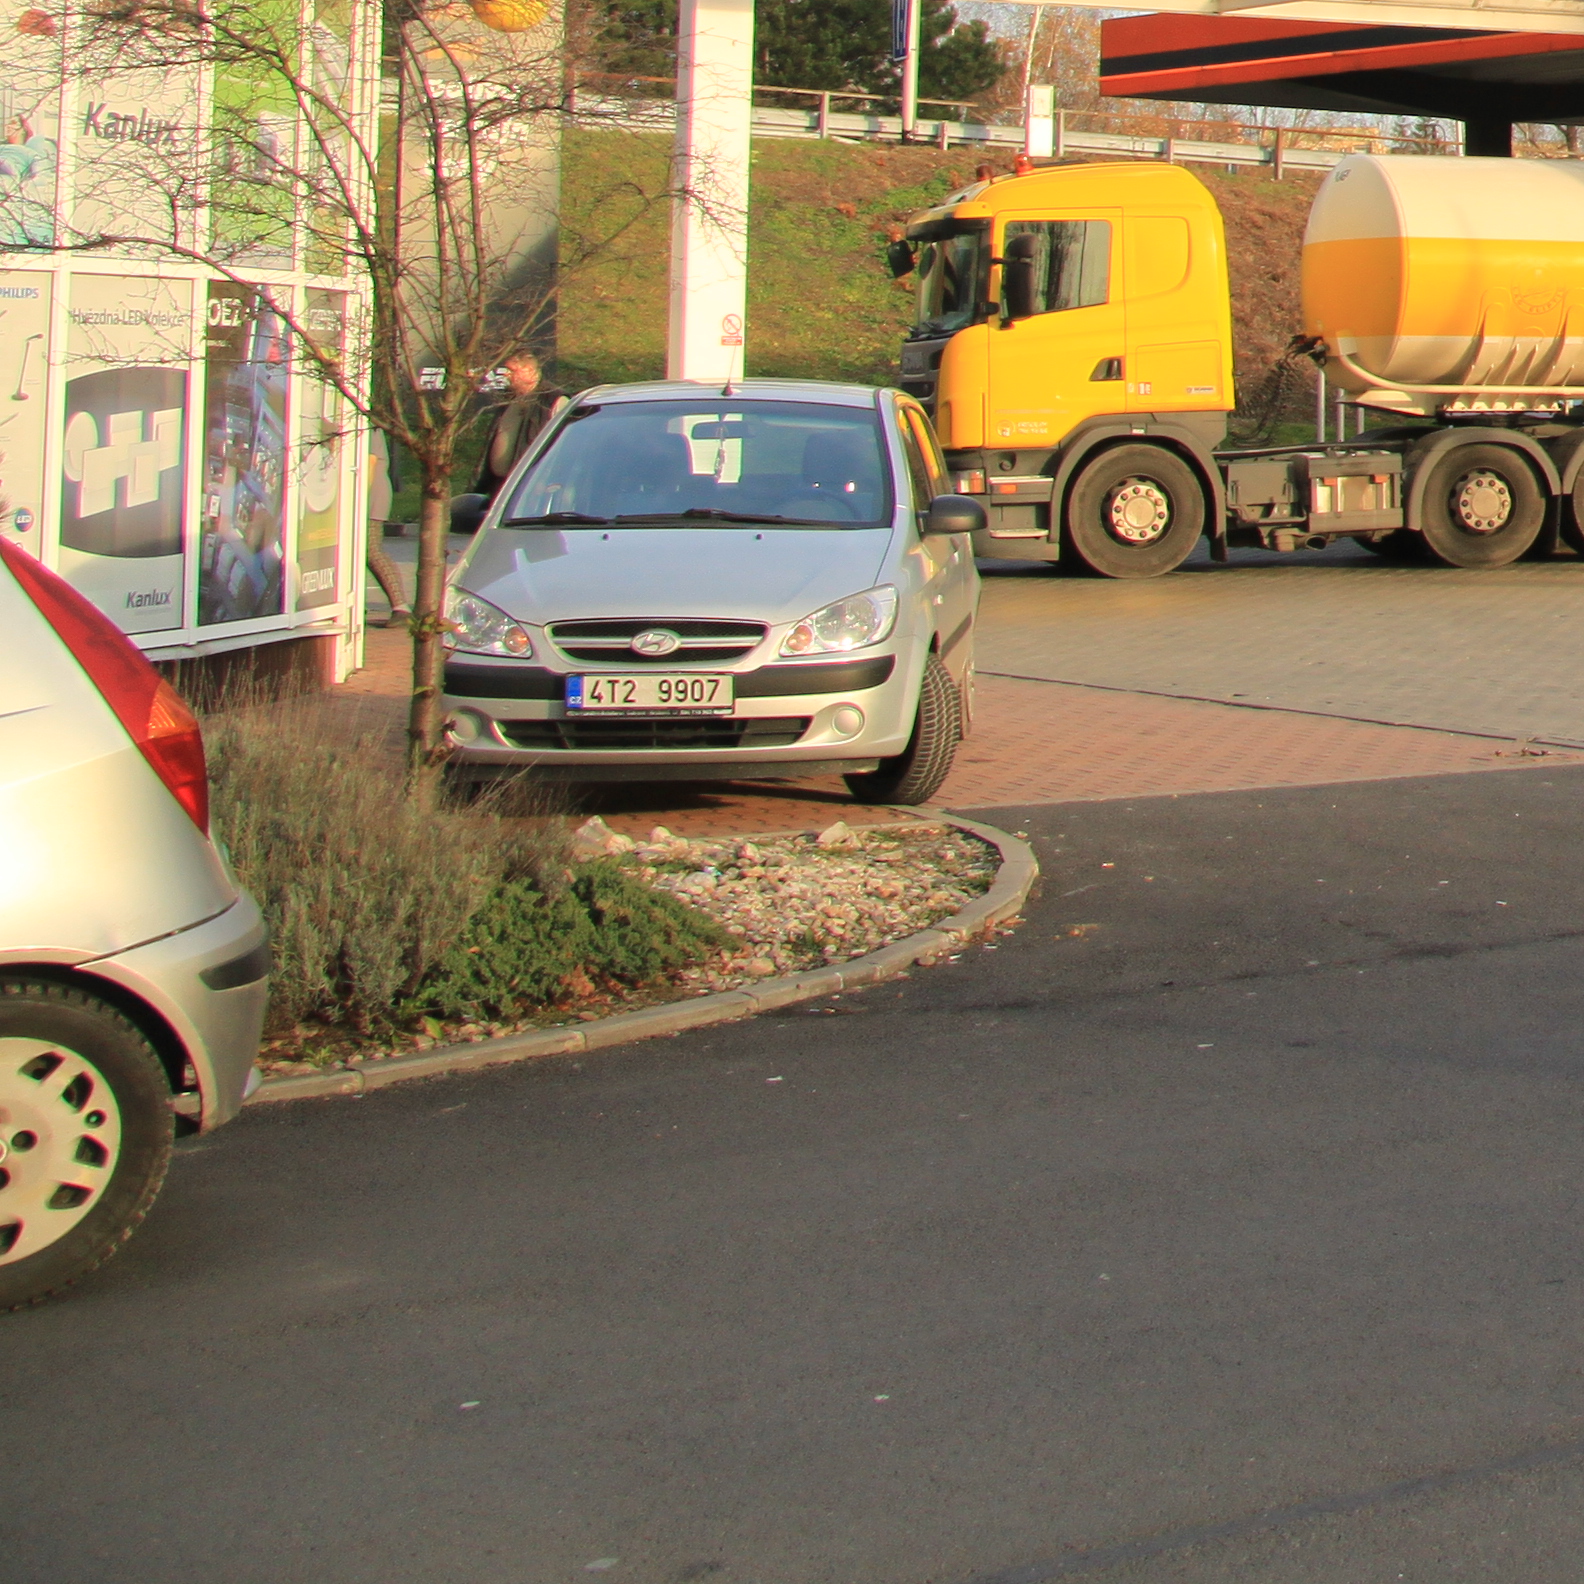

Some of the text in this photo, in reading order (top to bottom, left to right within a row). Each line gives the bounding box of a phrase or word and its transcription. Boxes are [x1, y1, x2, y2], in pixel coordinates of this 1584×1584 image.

[126, 587, 174, 608] Kanlux
[569, 696, 582, 704] CZ
[590, 679, 720, 704] 4T2 9907
